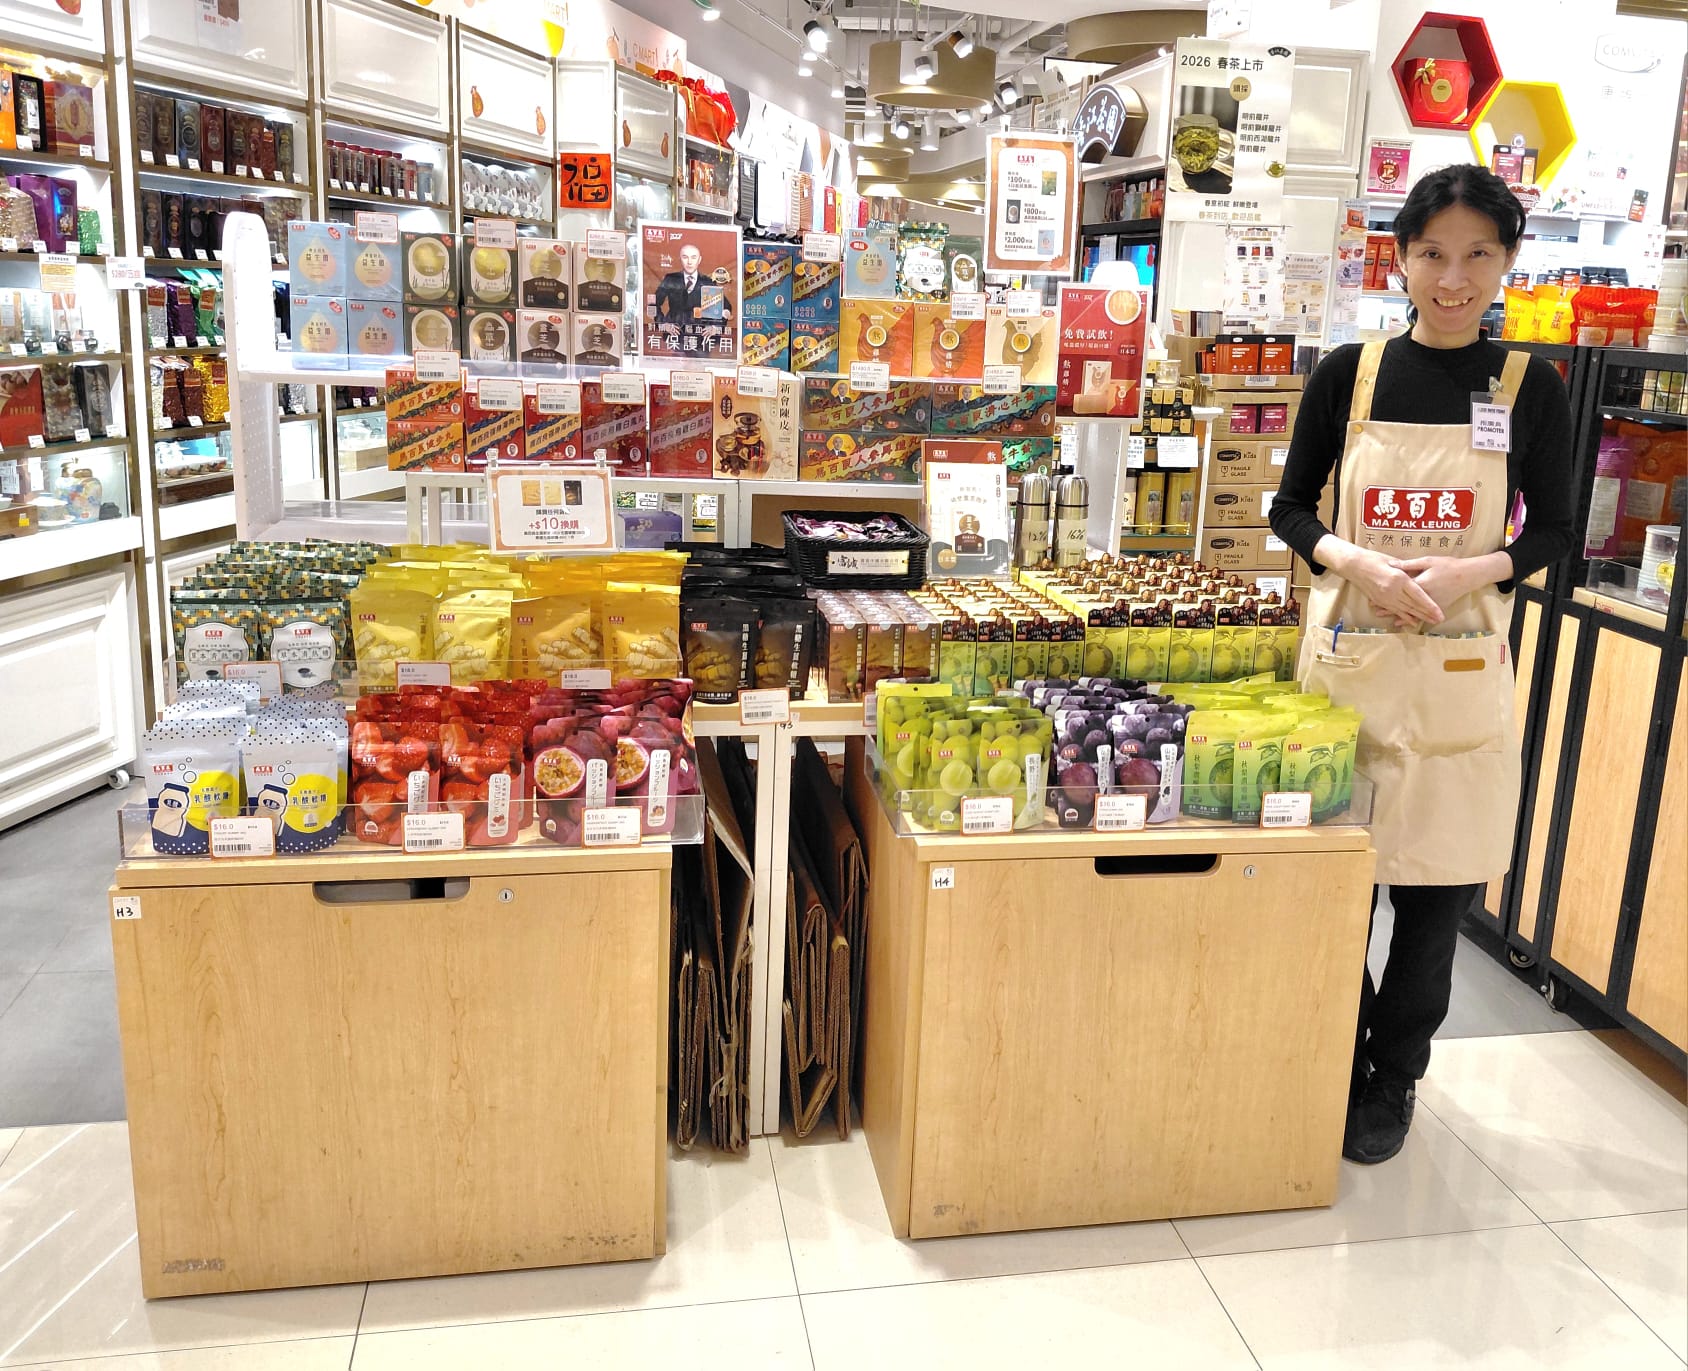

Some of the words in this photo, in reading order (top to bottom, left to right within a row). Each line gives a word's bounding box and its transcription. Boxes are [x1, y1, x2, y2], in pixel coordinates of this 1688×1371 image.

[1181, 55, 1211, 67] 2026
[1217, 57, 1264, 72] 春茶上市
[564, 157, 609, 203] 福
[647, 335, 734, 352] 有保護作用
[780, 383, 791, 431] 新會陳皮
[1476, 426, 1505, 434] PROMOTER
[1373, 489, 1463, 520] 馬百良
[1372, 518, 1390, 528] MA
[1394, 519, 1417, 528] PAK
[1421, 519, 1462, 529] LEUNG
[1066, 529, 1086, 542] 16%
[1365, 533, 1465, 548] 天然保健食品
[935, 877, 951, 888] H4
[116, 907, 134, 918] H3
